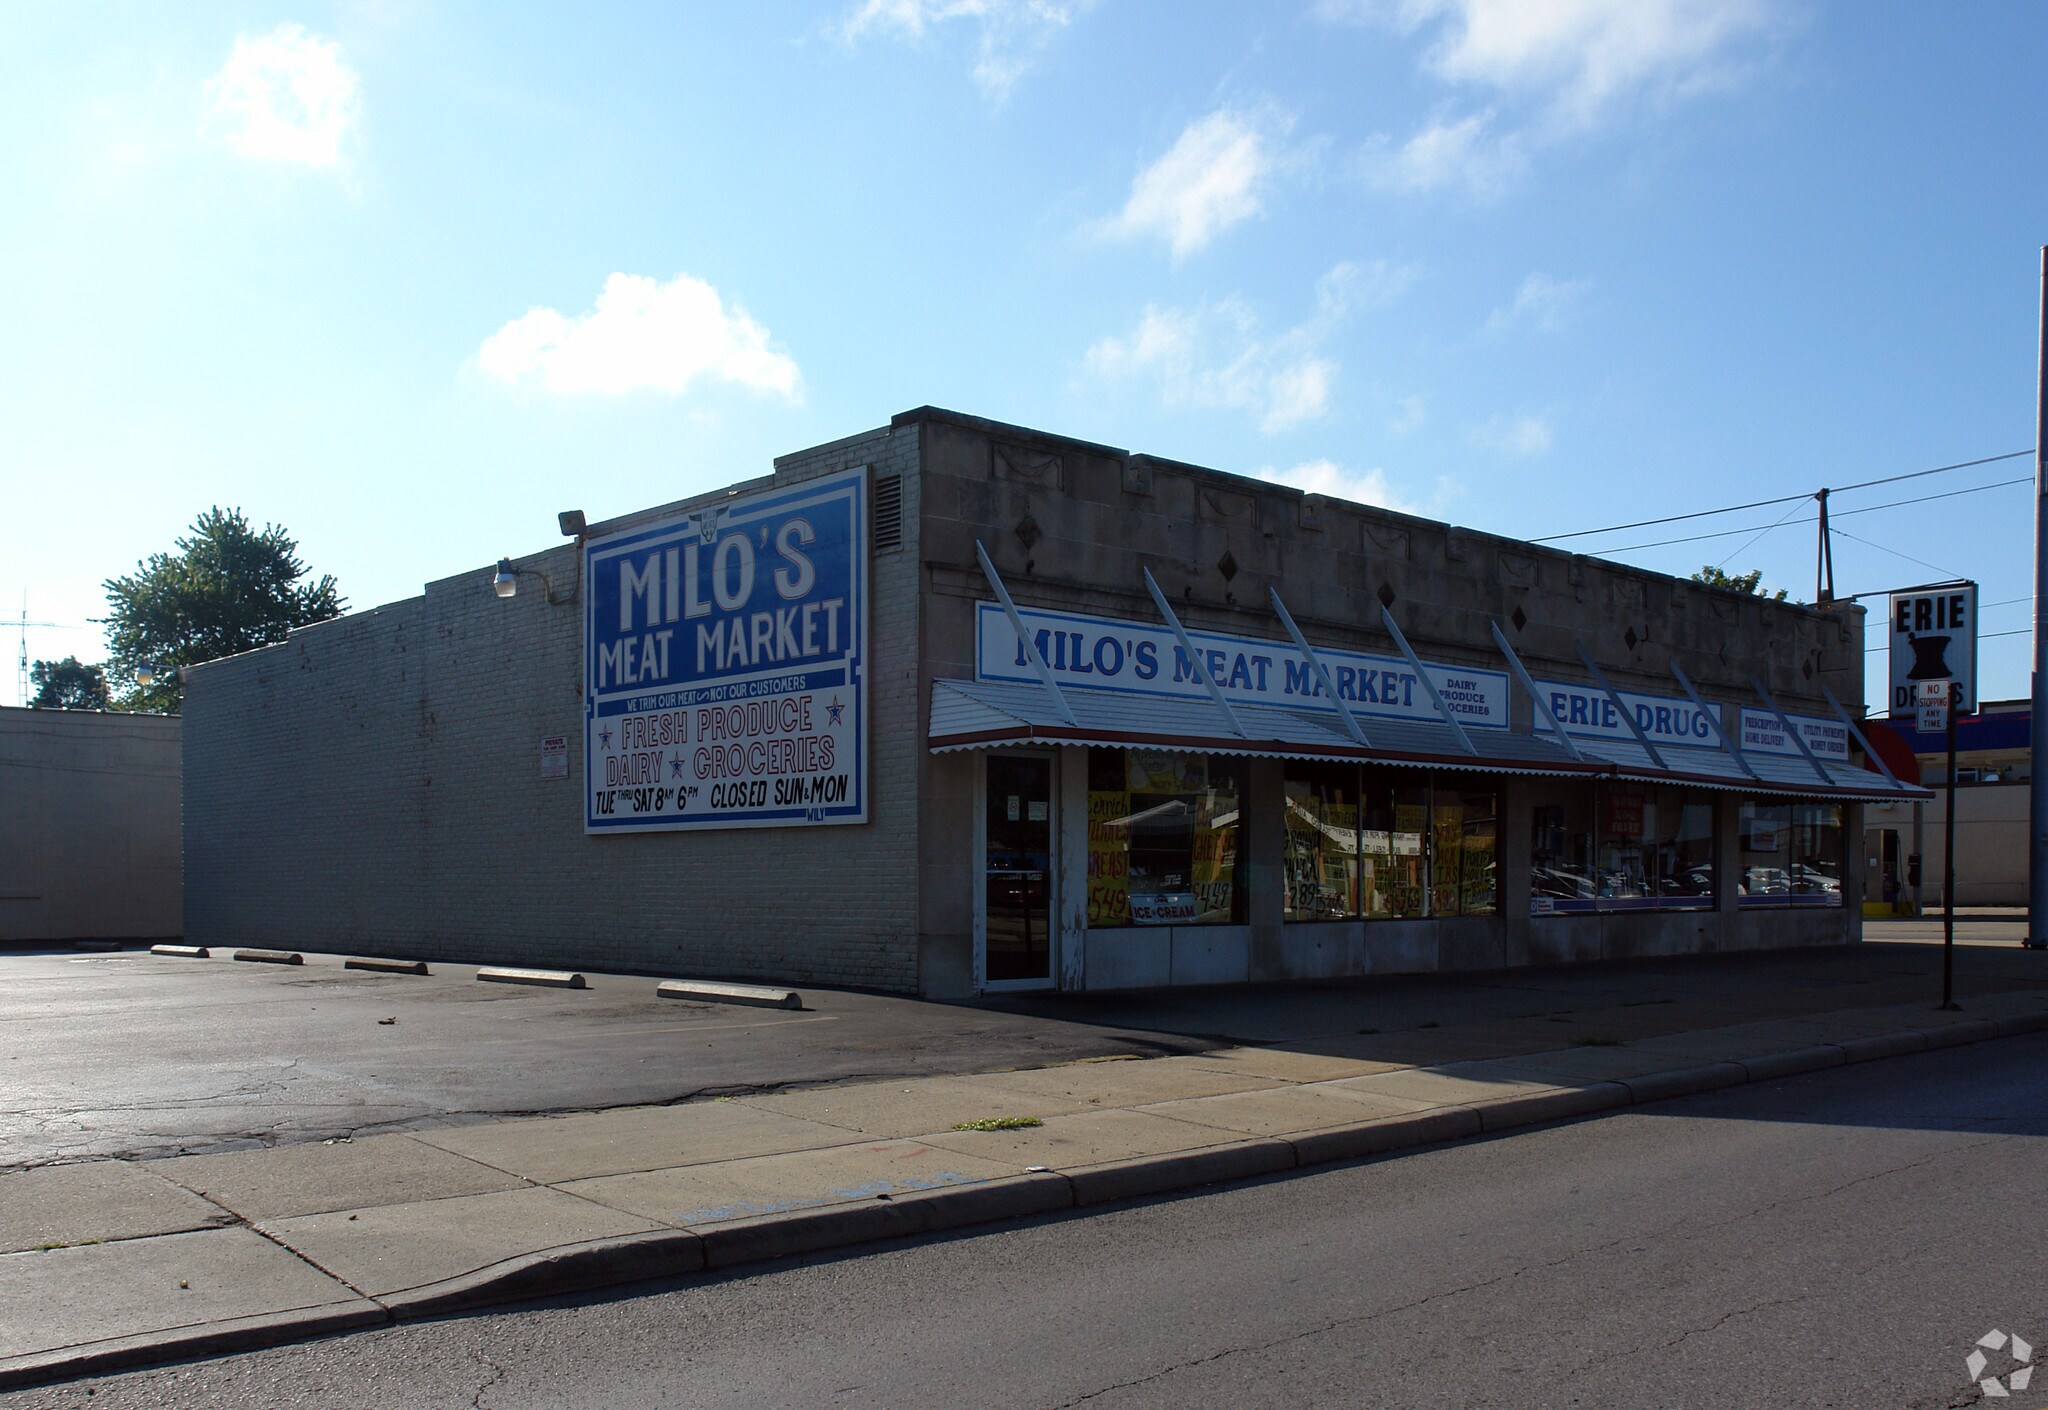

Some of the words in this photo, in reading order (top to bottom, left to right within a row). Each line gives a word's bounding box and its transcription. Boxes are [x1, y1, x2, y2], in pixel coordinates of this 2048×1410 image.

[619, 517, 816, 632] MILO'S
[1896, 595, 1964, 632] ERIE
[598, 628, 674, 689] MEAT
[696, 597, 844, 673] MARKET
[1015, 628, 1159, 680] MILO'S
[1172, 645, 1272, 692] MEAT
[627, 699, 638, 713] WE
[640, 696, 657, 711] TRIM
[658, 693, 677, 708] OUR
[678, 690, 697, 706] MEAT
[710, 686, 728, 701] NOT
[729, 683, 748, 698] OUR
[749, 676, 806, 696] CUSTOMERS
[1439, 689, 1485, 703] PRODUCE
[1447, 679, 1477, 691] DAIRY
[1896, 682, 1963, 708] DRS
[1919, 697, 1948, 708] STOPPING
[1927, 684, 1939, 694] NO
[622, 711, 687, 750] FRESH
[697, 695, 812, 742] PRODUCE
[1551, 692, 1618, 728] ERIE
[1636, 703, 1709, 738] DRUG
[1924, 719, 1941, 728] TIME
[1926, 709, 1940, 717] ANY
[606, 750, 663, 787] DAIRY
[693, 734, 835, 780] GROCERIES
[596, 790, 616, 815] TUE
[618, 789, 633, 801] THRU
[633, 788, 654, 812] SAT
[711, 780, 767, 808] CLOSED
[1134, 907, 1151, 918] ICE
[1157, 906, 1195, 918] CREAM
